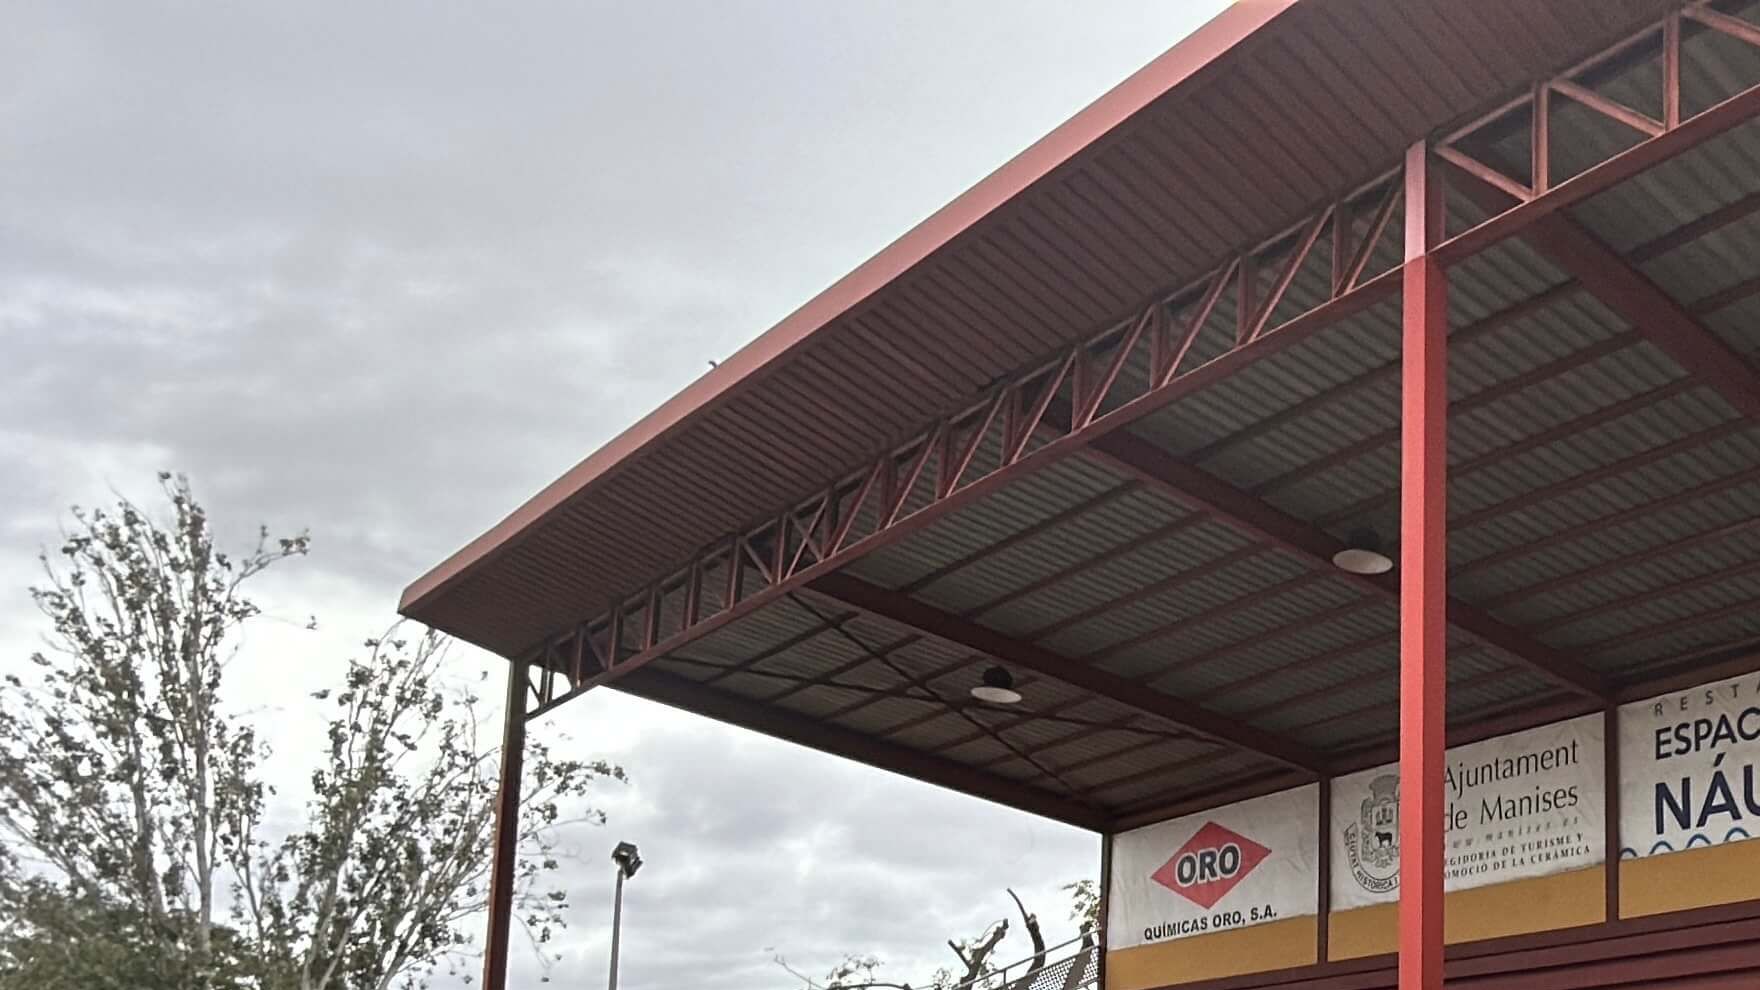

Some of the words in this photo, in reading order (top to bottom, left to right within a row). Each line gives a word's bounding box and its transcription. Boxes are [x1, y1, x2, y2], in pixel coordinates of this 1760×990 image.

[1480, 785, 1579, 826] Manises
[1502, 846, 1516, 857] DE
[1520, 834, 1573, 853] TURISME
[1576, 832, 1584, 842] Y
[1176, 843, 1241, 887] ORO
[1493, 860, 1507, 871] DE
[1512, 856, 1525, 868] LA
[1144, 916, 1209, 941] QUÍMICAS
[1212, 910, 1247, 928] ORO,
[1250, 904, 1278, 921] S.A.
